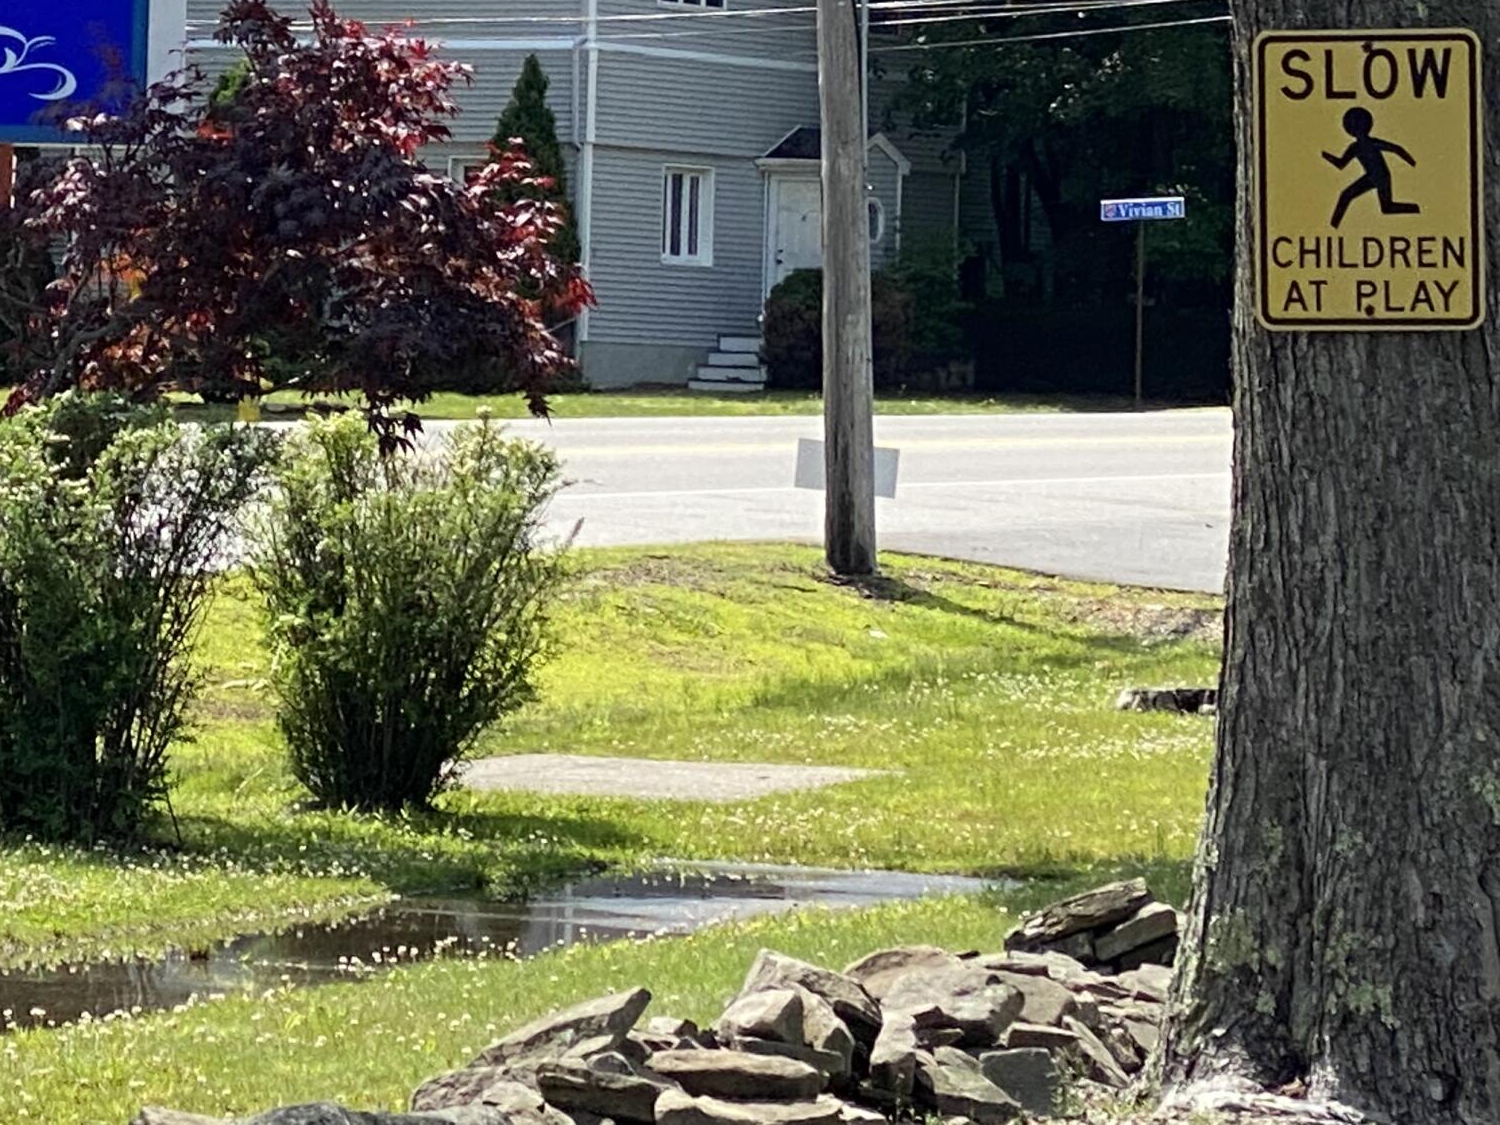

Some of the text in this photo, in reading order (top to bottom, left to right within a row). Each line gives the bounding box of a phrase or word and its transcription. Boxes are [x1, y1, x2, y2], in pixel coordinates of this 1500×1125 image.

[1281, 47, 1451, 101] SLOW
[1117, 201, 1180, 217] Vivian St
[1272, 236, 1465, 269] CHILDREN
[1283, 280, 1459, 312] AT PLAY
